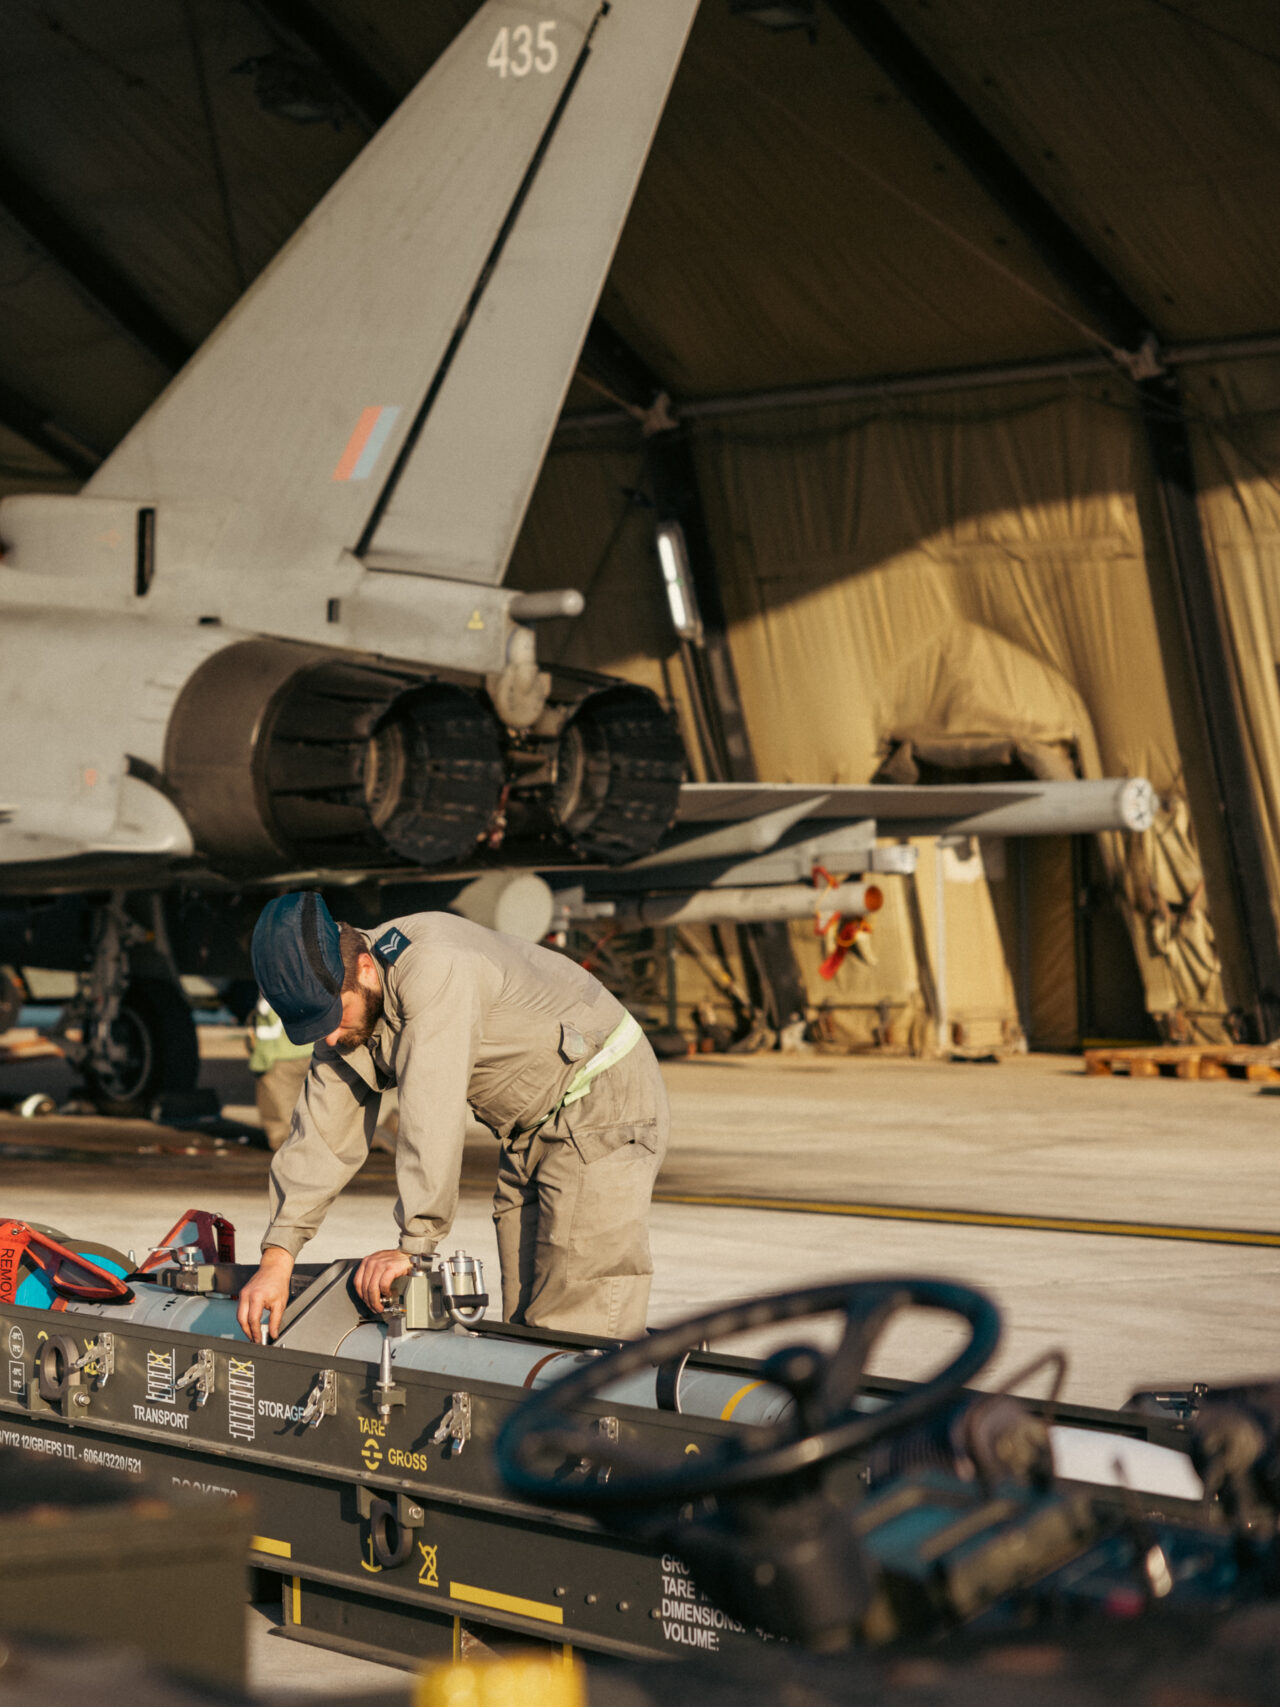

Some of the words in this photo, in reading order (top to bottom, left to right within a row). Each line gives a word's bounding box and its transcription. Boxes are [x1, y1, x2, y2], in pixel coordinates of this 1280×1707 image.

[487, 20, 558, 78] 435
[0, 1248, 15, 1303] REMOV
[133, 1404, 189, 1430] TRANSPORT
[357, 1416, 386, 1437] TARE
[388, 1448, 428, 1472] GROSS
[662, 1575, 696, 1600] TARE
[663, 1621, 720, 1652] VOLUME:
